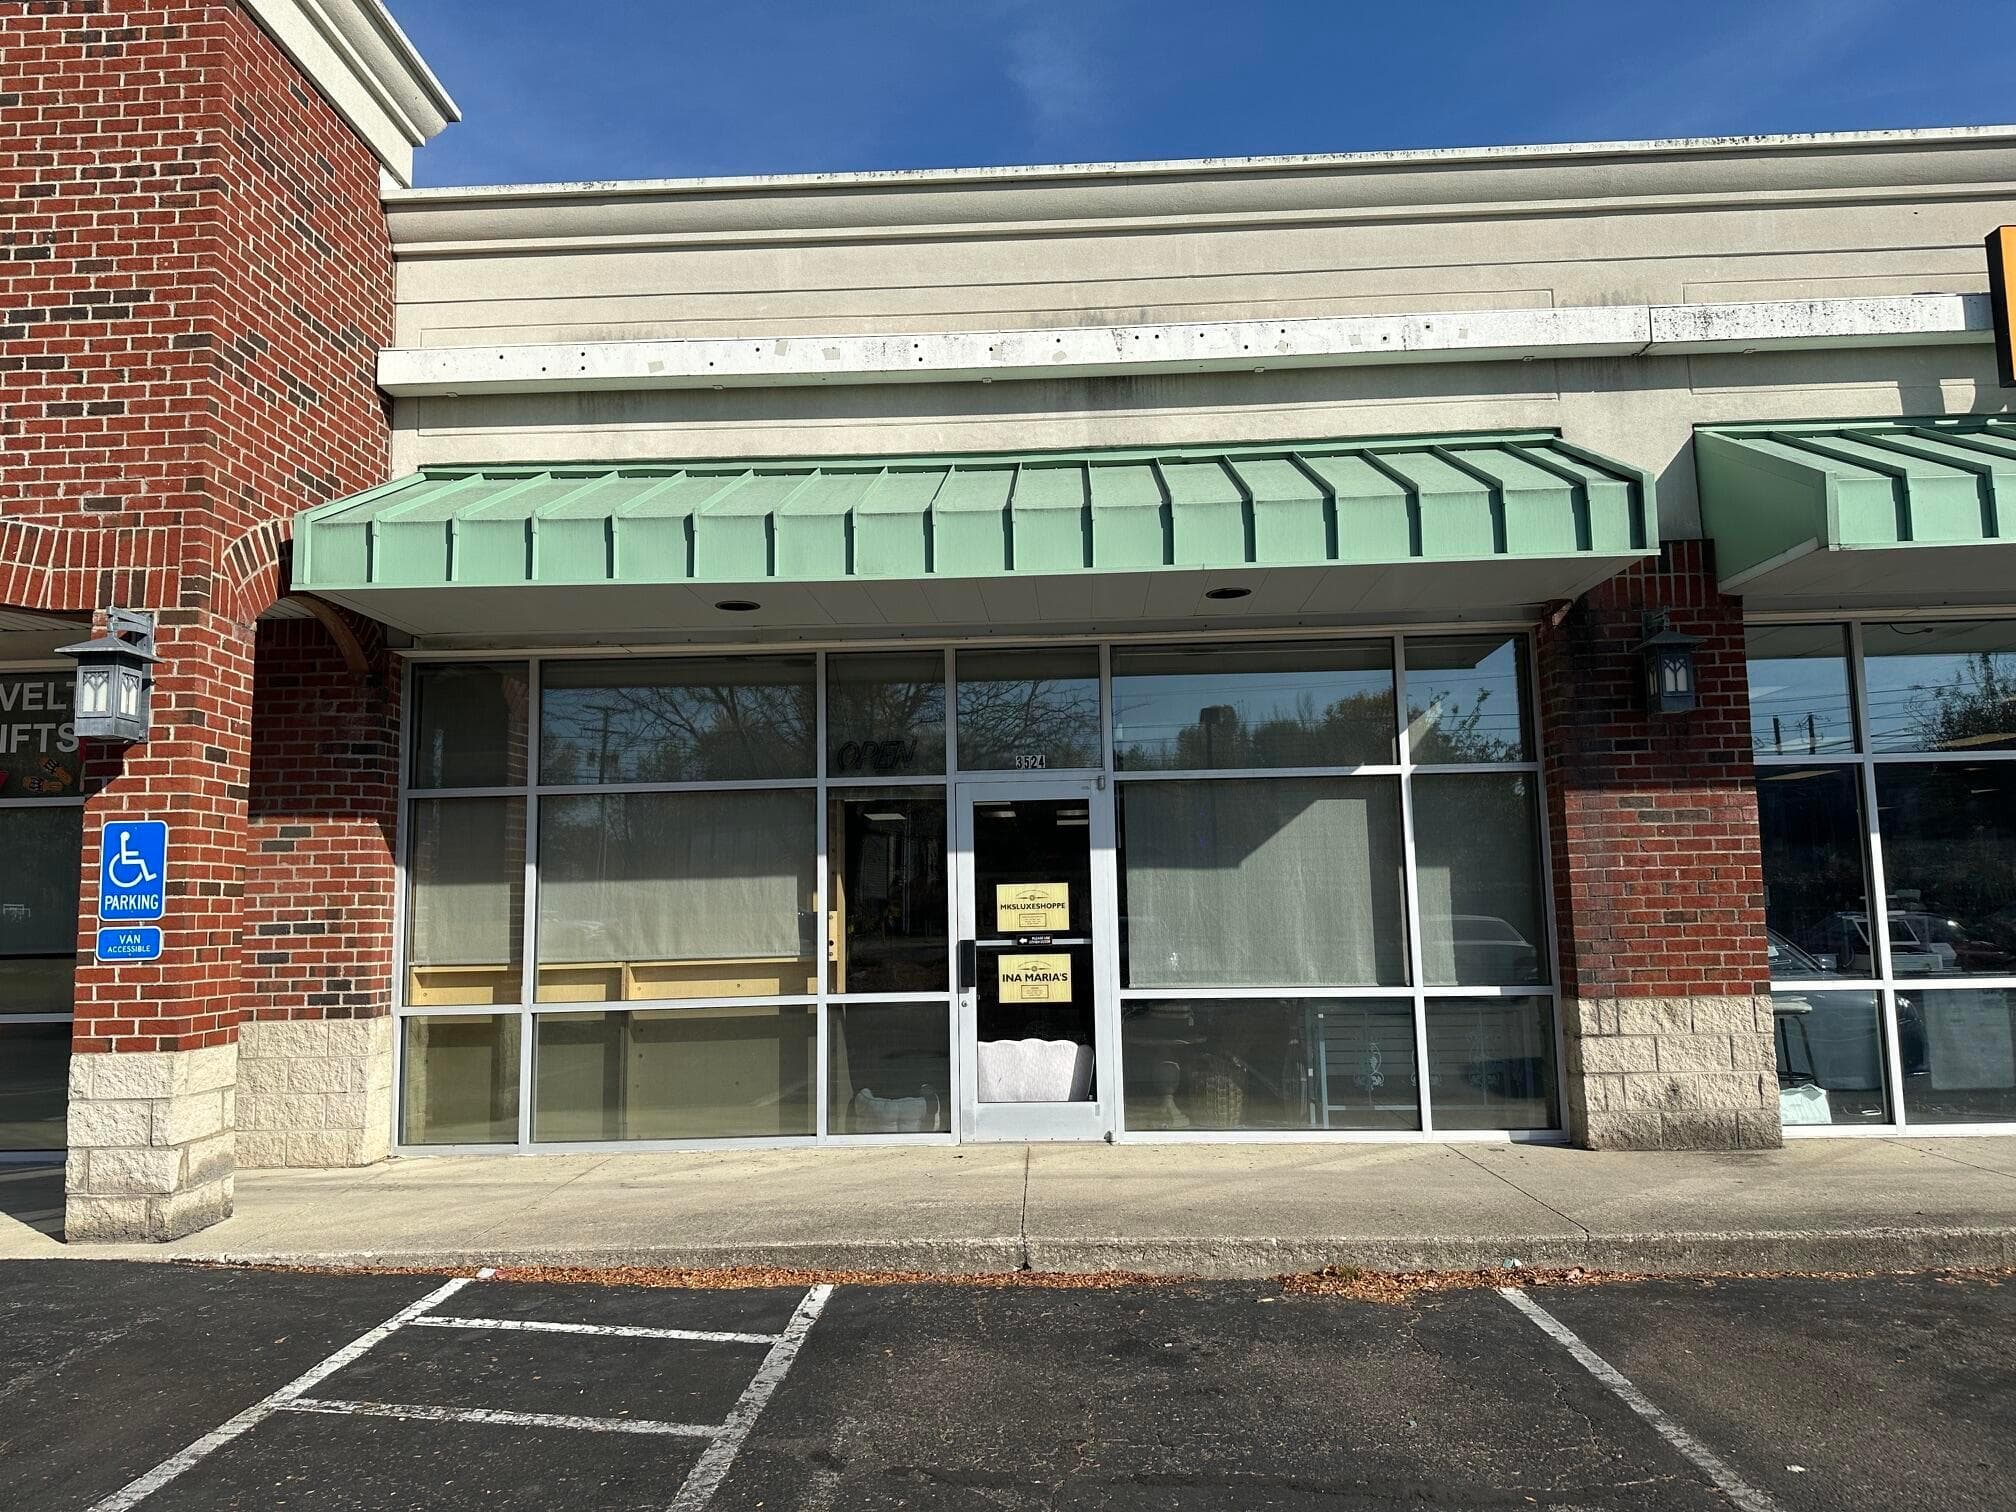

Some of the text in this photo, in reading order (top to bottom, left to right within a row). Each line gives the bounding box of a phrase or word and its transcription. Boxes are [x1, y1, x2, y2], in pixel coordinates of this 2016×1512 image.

[838, 737, 918, 770] OPEN
[1016, 755, 1045, 769] 3524
[104, 894, 159, 911] PARKING
[1000, 902, 1066, 910] MKSLUXESHOPPE
[119, 934, 141, 944] VAN
[107, 945, 151, 953] ACCESSIBLE
[1002, 973, 1068, 982] INA MARIA'S
